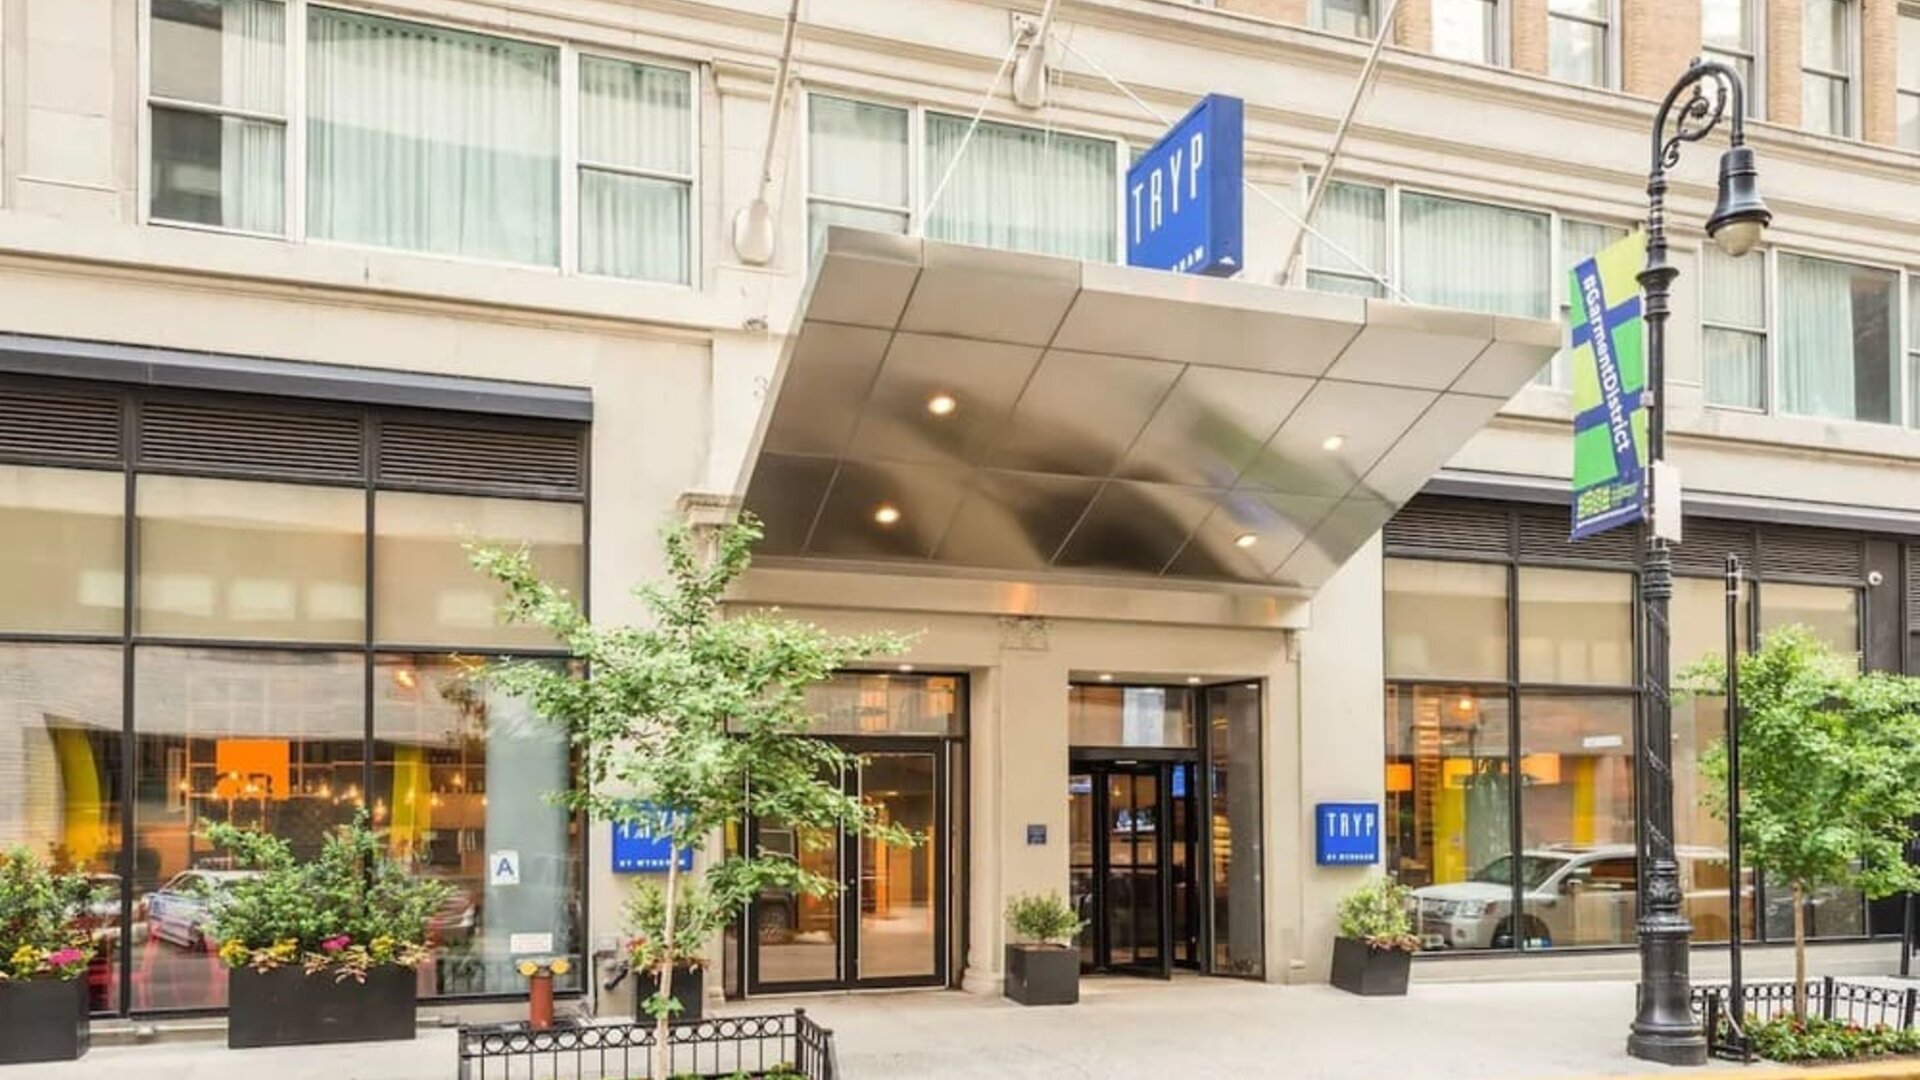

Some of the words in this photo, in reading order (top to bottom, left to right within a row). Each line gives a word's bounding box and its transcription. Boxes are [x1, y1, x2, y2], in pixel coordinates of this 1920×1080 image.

[1132, 131, 1203, 244] TRYP
[1583, 275, 1630, 452] #GarmentDistrict
[1327, 812, 1374, 837] TRYP
[497, 858, 514, 876] A
